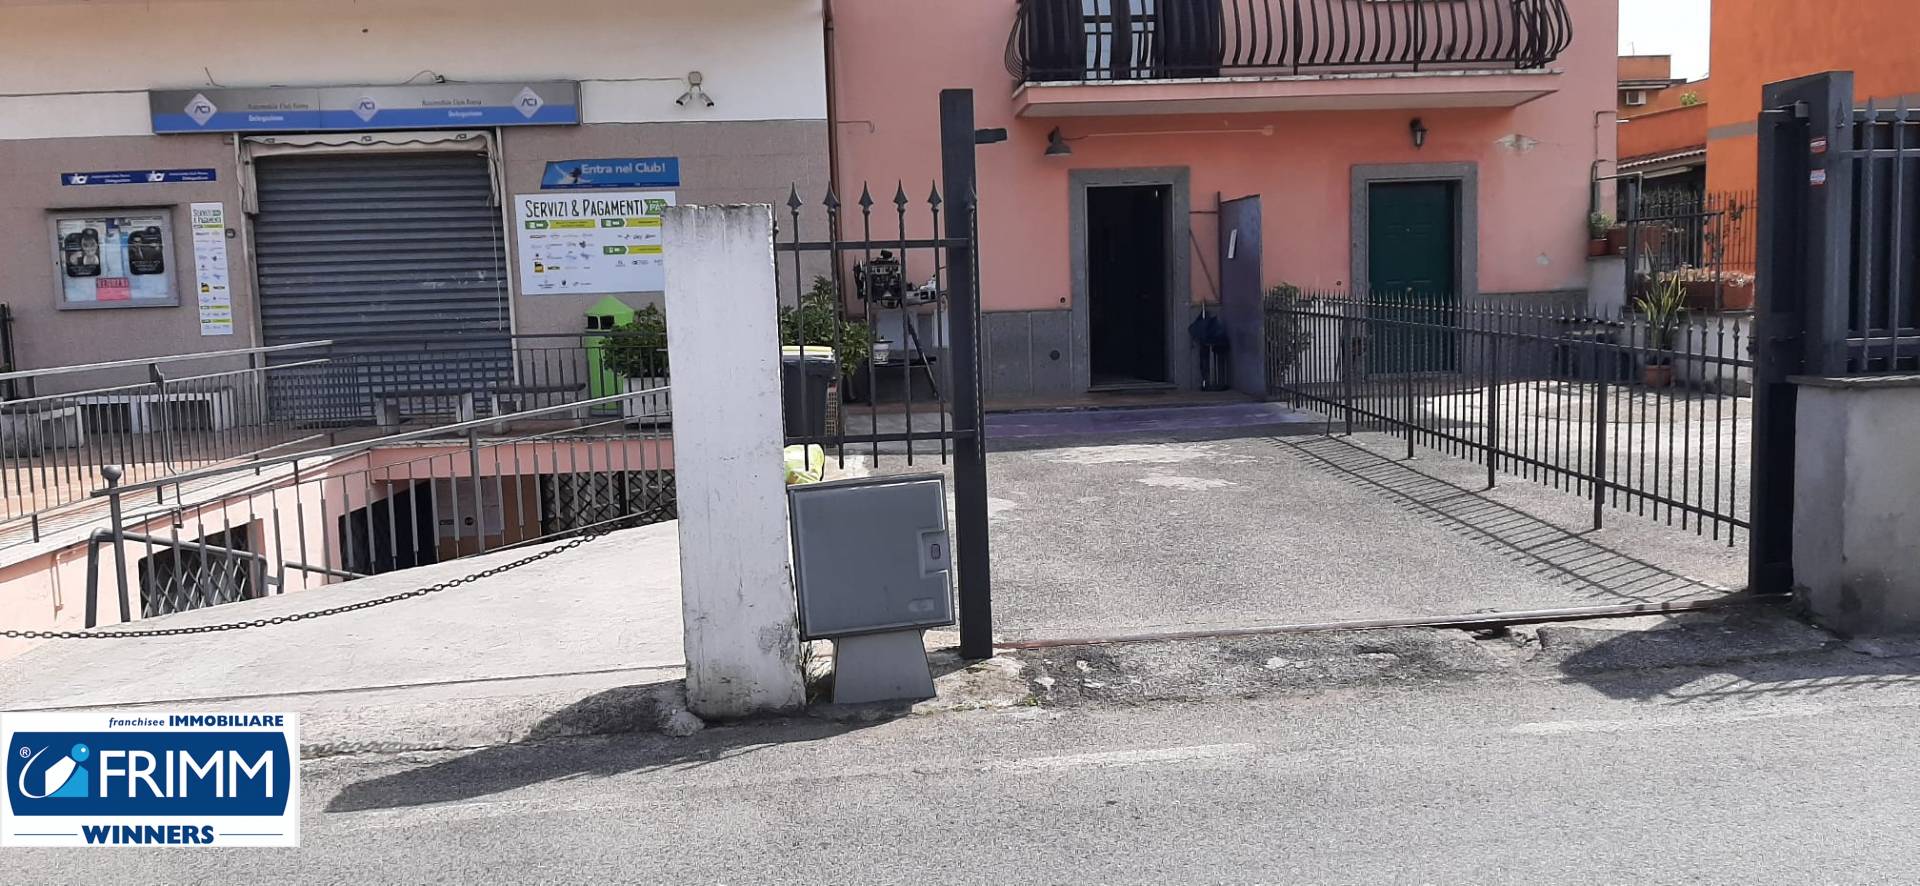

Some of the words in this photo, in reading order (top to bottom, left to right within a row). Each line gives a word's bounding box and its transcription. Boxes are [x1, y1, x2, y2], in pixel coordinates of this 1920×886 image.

[521, 97, 538, 107] ACI
[581, 164, 613, 174] Entra
[615, 162, 633, 173] nel
[634, 162, 666, 173] Club!
[571, 200, 580, 216] &
